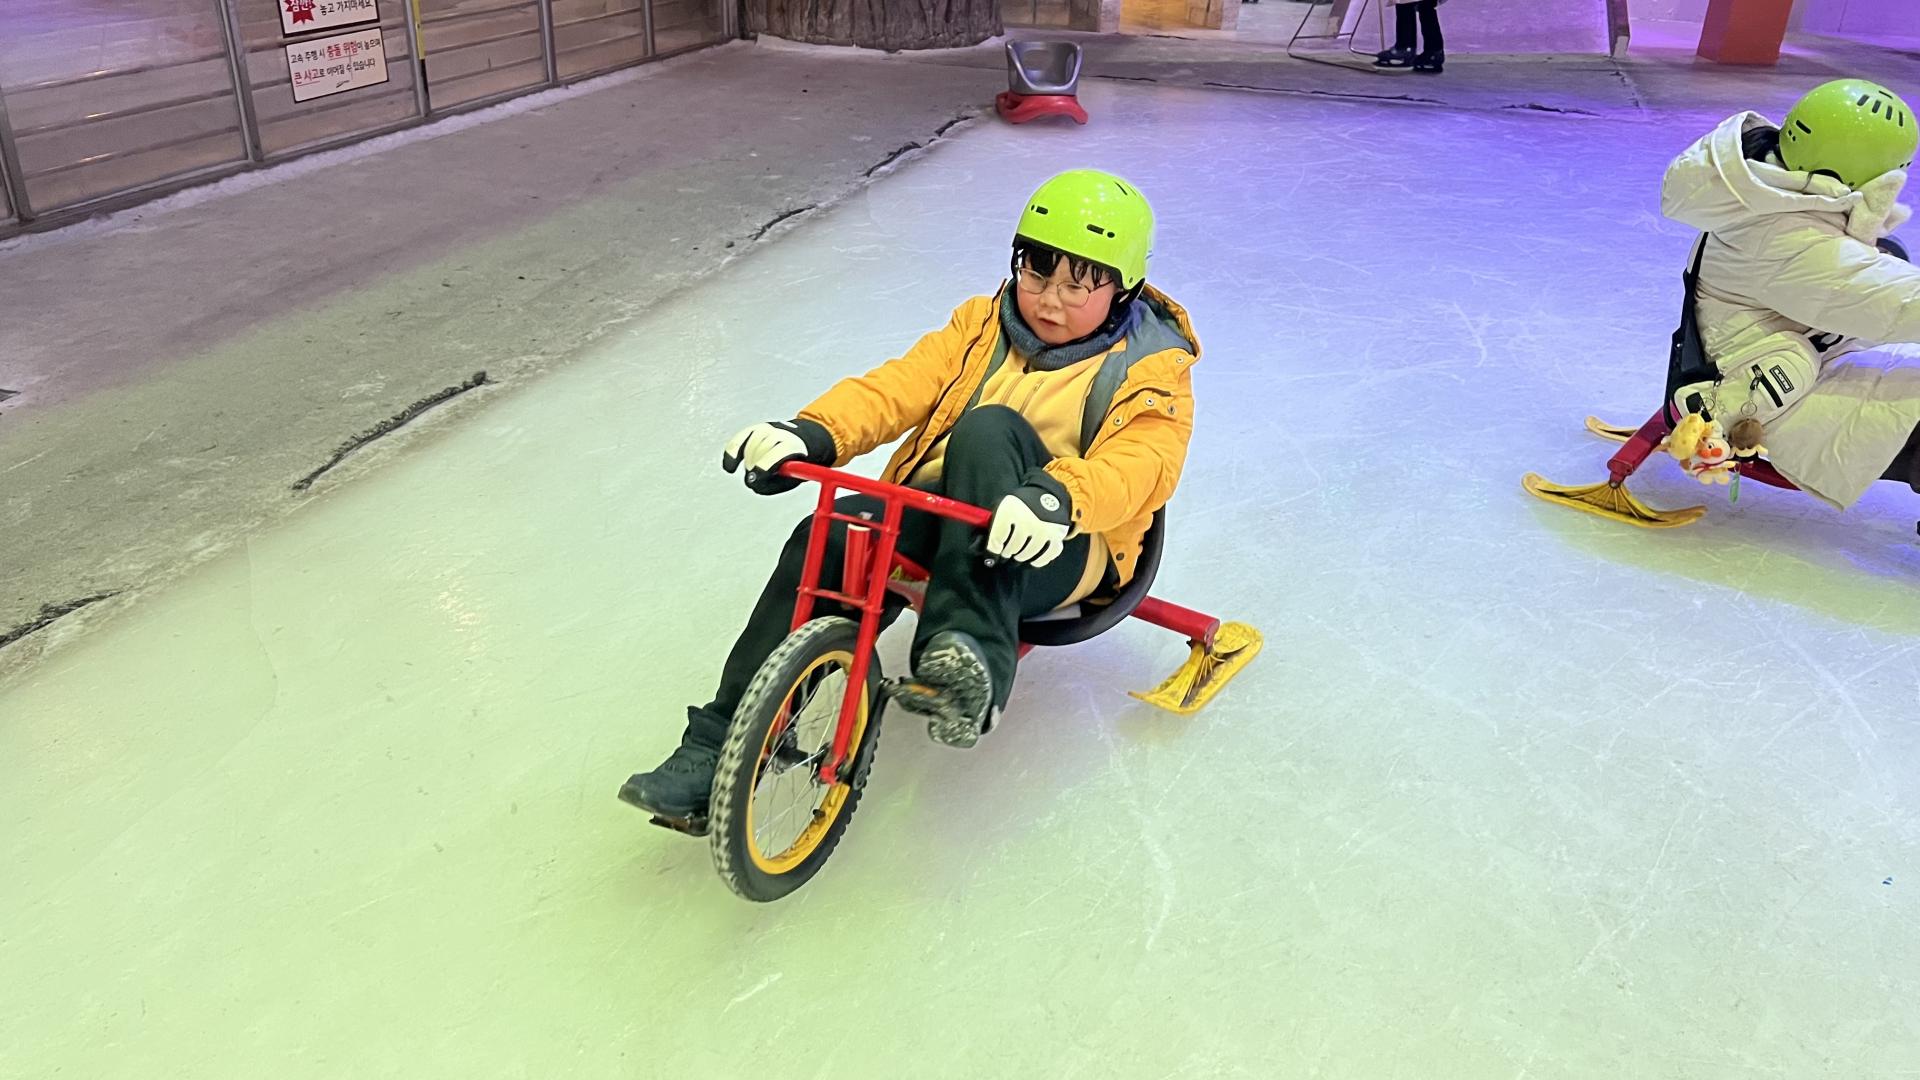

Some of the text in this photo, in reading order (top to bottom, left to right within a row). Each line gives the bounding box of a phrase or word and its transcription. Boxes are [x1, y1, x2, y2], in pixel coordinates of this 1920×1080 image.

[320, 3, 335, 16] 놓고
[290, 38, 382, 64] 고속 주행 시 충돌 위험이 높으며
[294, 58, 376, 85] 큰 사고로 이어질 수 있습니다
